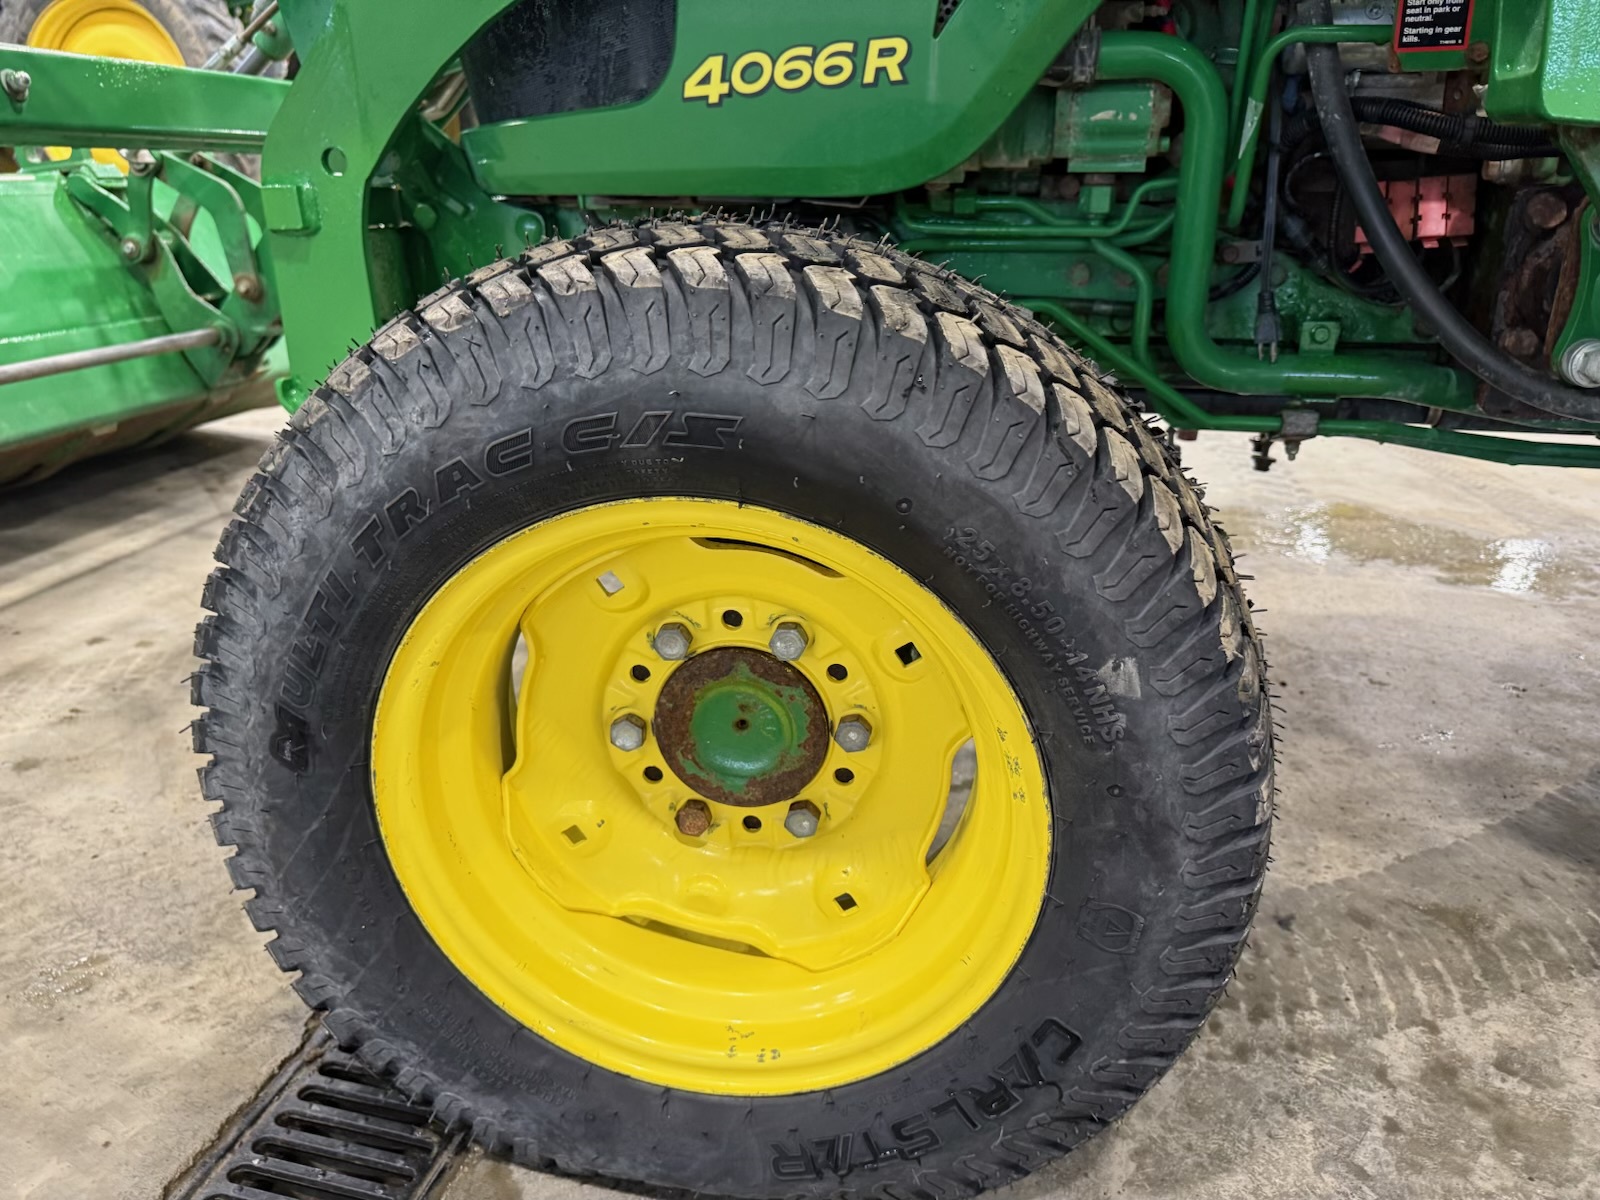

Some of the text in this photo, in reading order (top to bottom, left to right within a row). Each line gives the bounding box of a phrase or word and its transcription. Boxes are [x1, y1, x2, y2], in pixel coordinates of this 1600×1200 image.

[1403, 26, 1434, 35] Starting
[1444, 26, 1462, 34] gear
[1405, 14, 1434, 22] neutral.
[1424, 6, 1432, 14] in
[1433, 6, 1451, 14] park
[350, 427, 533, 566] TRAC
[944, 546, 1096, 745] NOT FOR HIGHWAY SERVICE
[770, 1017, 1083, 1180] CARLSTAR
